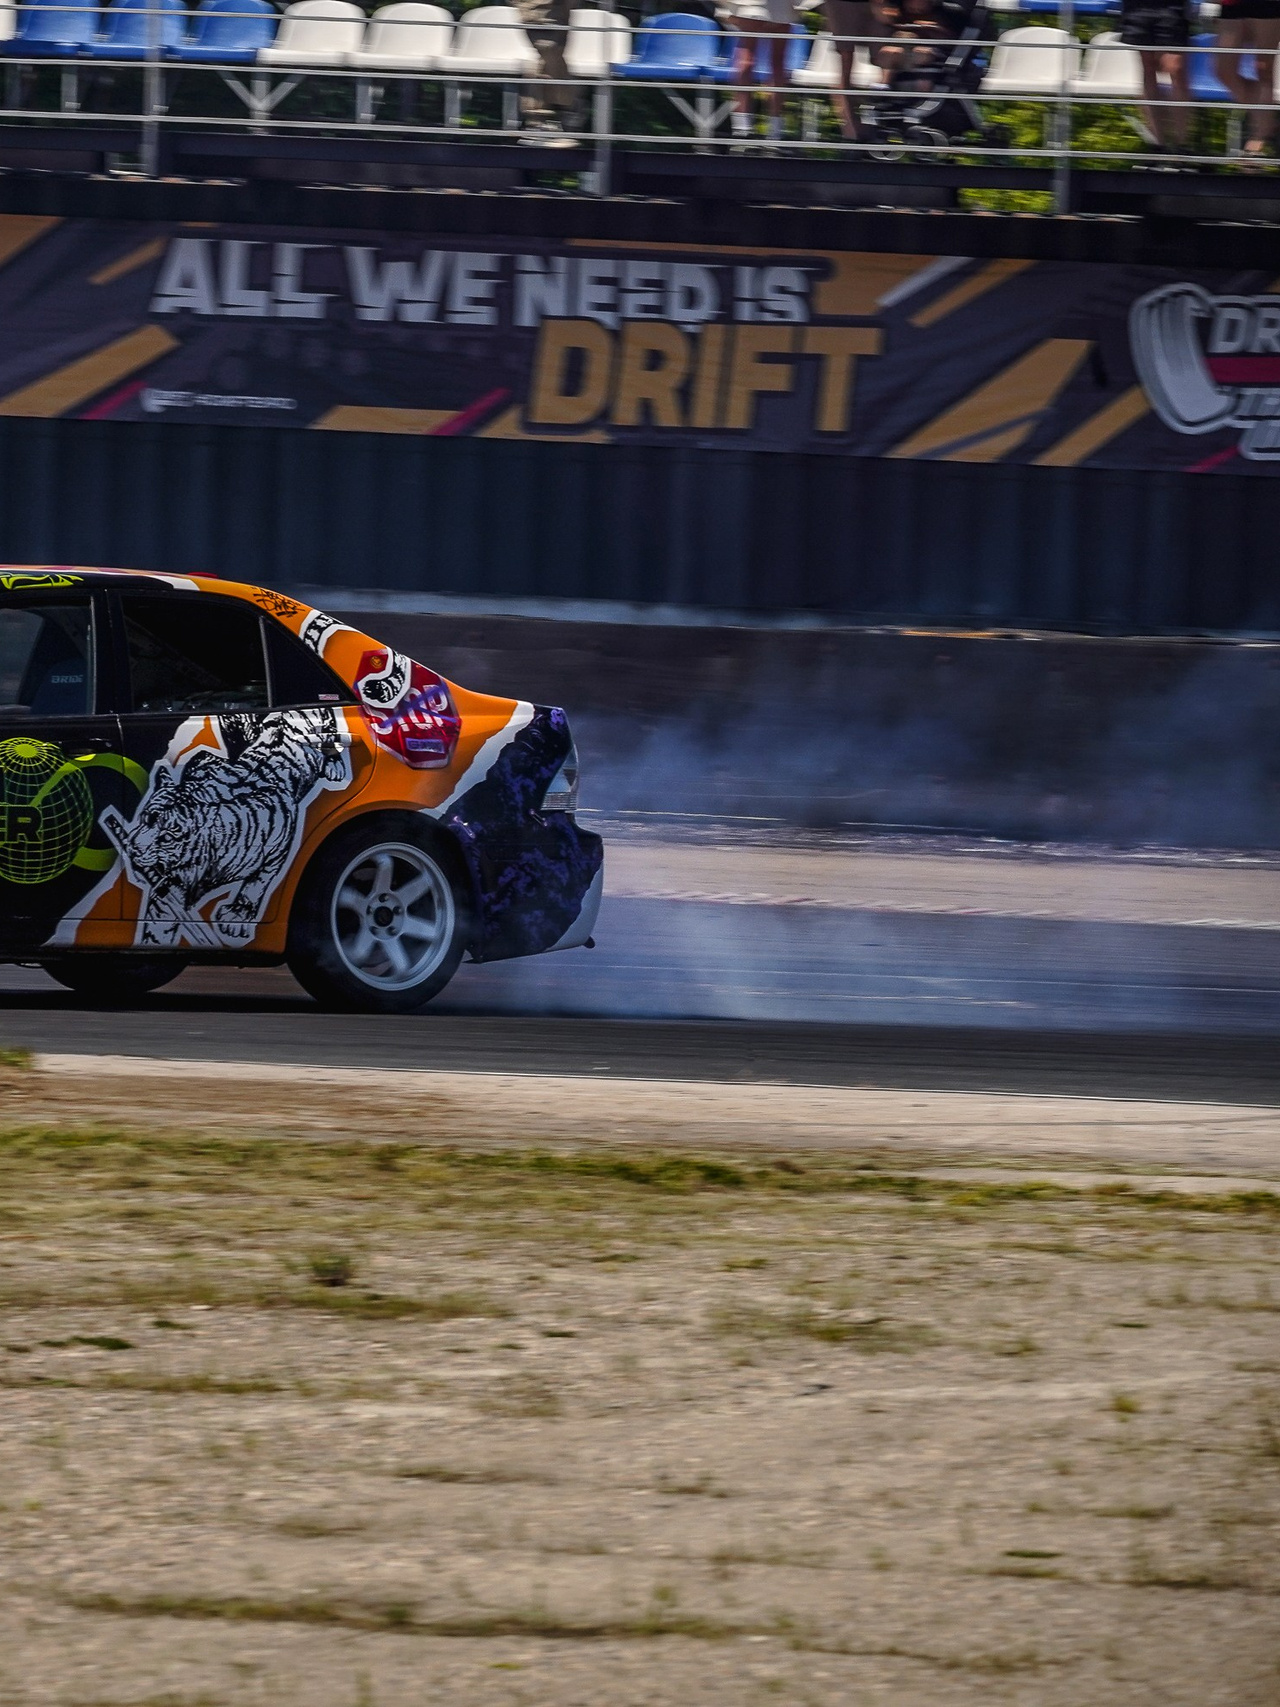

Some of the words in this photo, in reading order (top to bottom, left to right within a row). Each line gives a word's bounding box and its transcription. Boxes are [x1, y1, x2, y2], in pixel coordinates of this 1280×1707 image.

[148, 237, 338, 319] ALL
[344, 244, 507, 326] WE
[514, 254, 724, 332] NEED
[734, 264, 820, 322] IS
[525, 316, 884, 432] DRIFT
[51, 674, 84, 684] BRIDE
